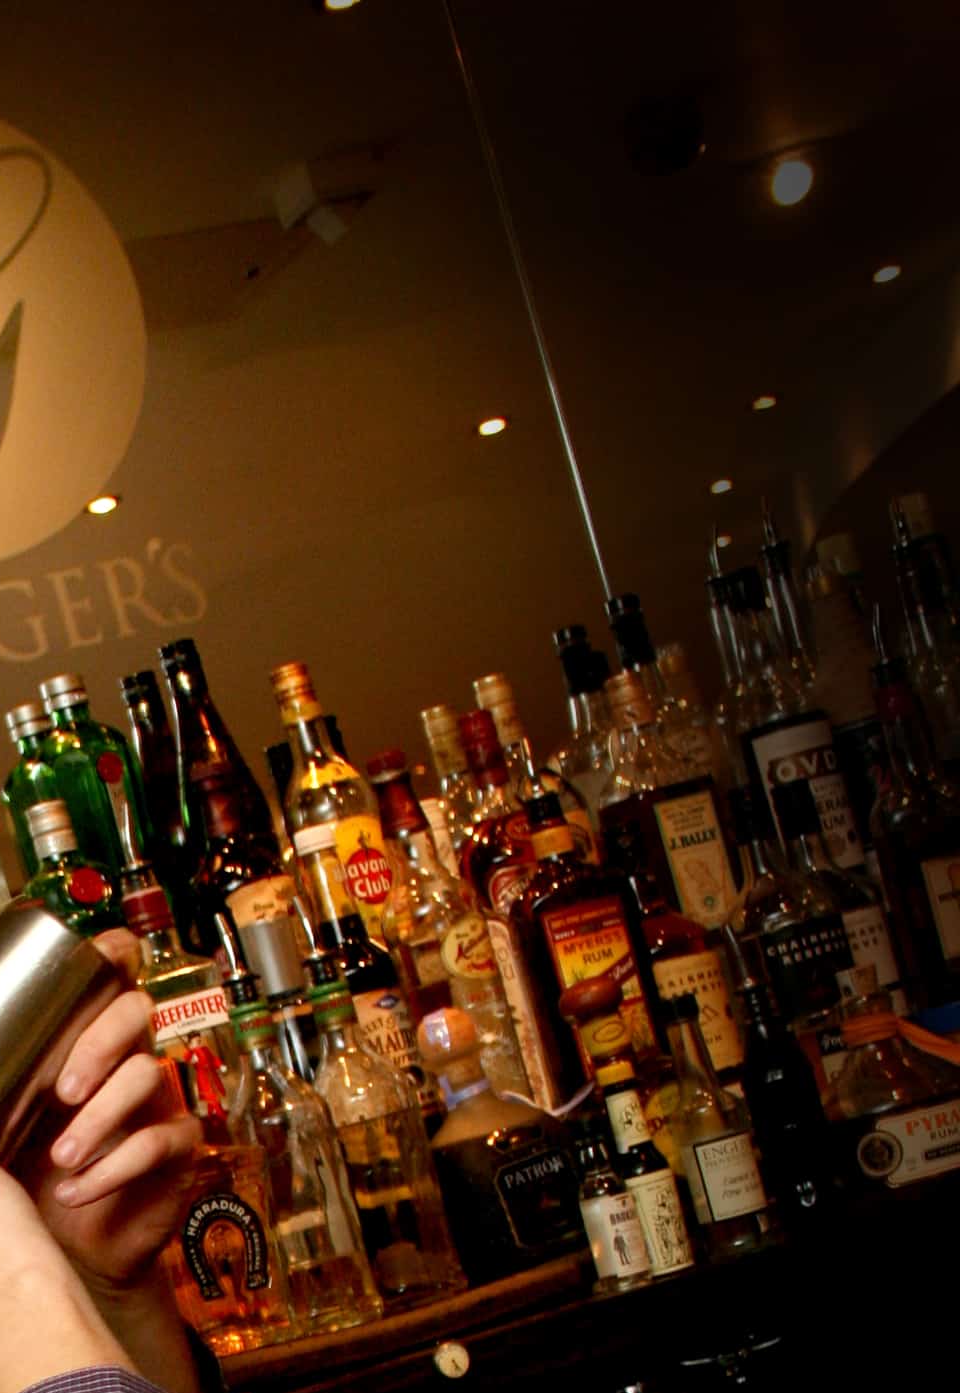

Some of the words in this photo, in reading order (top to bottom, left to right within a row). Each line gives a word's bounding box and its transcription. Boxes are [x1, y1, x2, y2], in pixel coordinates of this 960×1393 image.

[354, 874, 391, 899] Club
[583, 947, 615, 965] RUM
[151, 993, 229, 1033] BEEFEATER
[186, 1199, 252, 1238] HERRADURA
